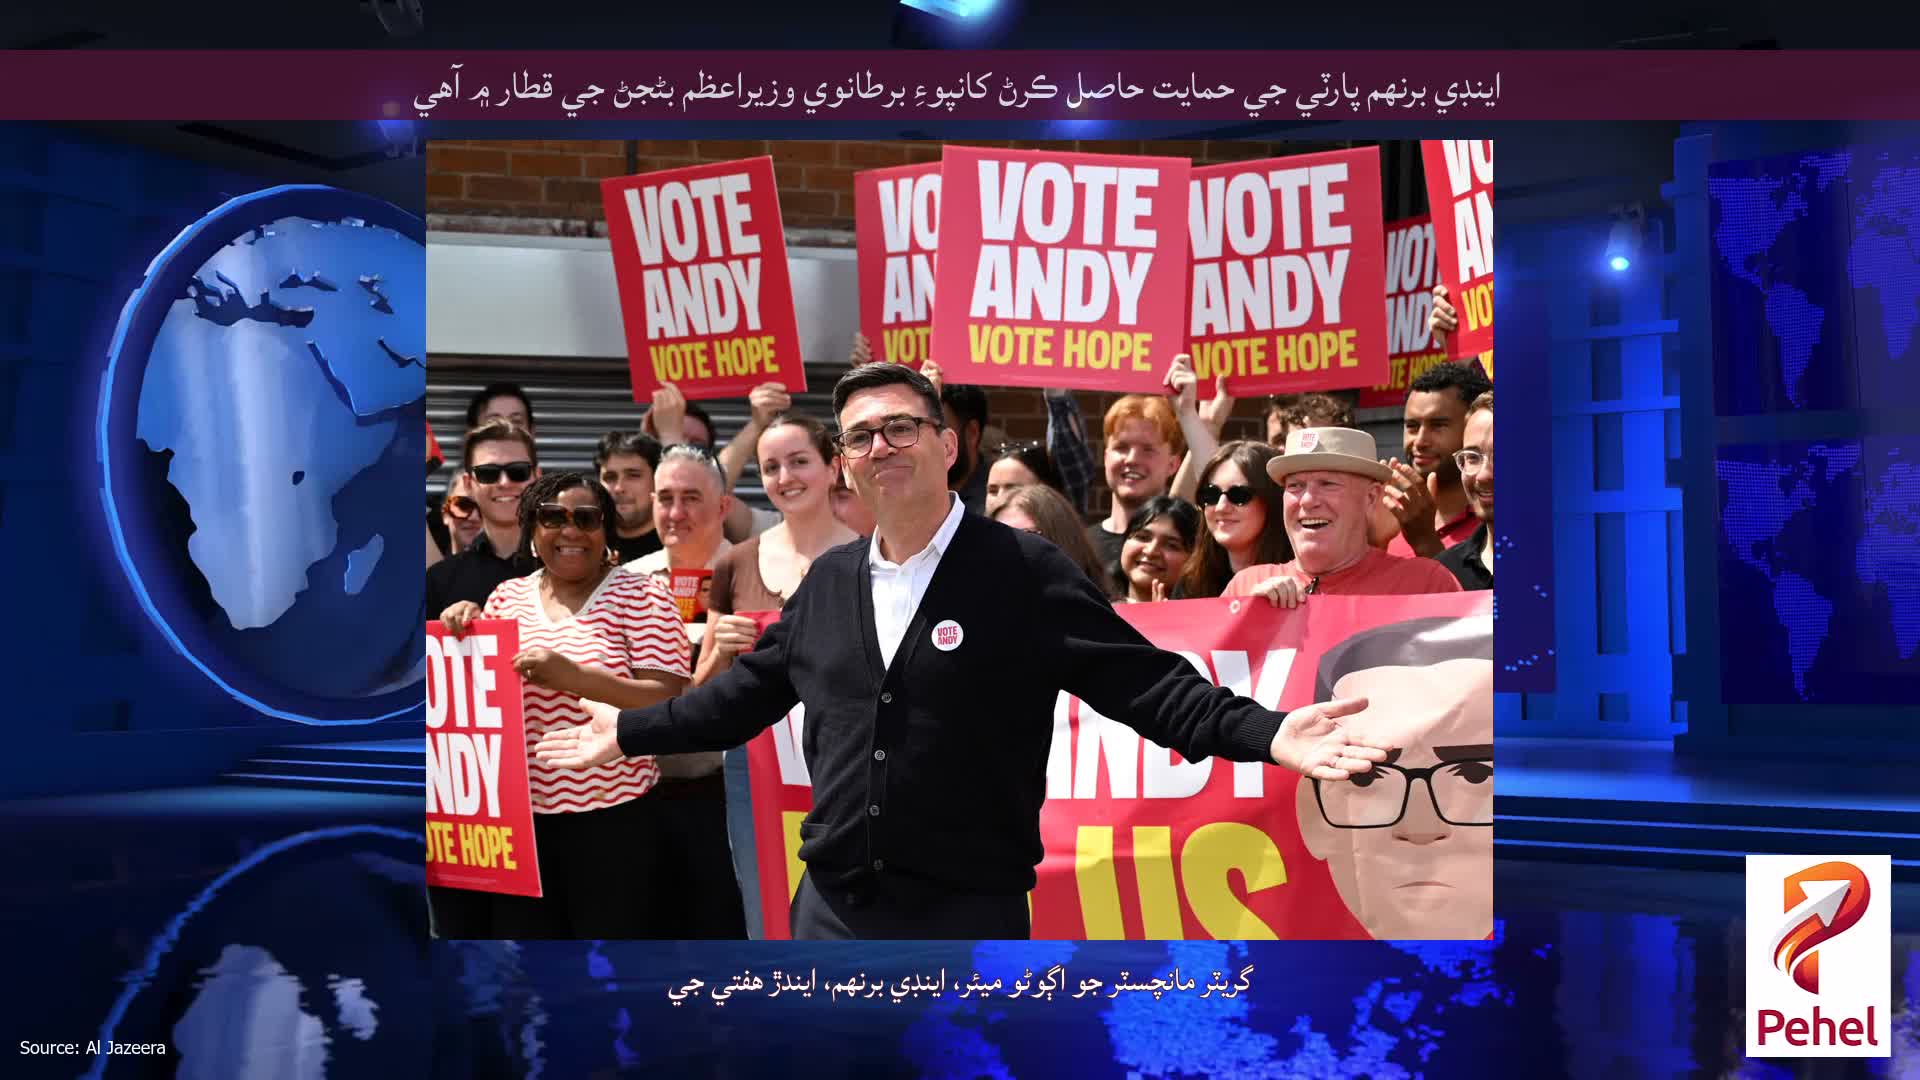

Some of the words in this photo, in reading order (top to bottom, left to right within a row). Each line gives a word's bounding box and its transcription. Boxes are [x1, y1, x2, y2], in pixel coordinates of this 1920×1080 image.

[624, 173, 760, 266] VOTE
[978, 160, 1159, 248] VOTE
[1188, 163, 1352, 259] VOTE
[969, 245, 1154, 325] ANDY
[1386, 223, 1441, 294] VOT
[642, 257, 761, 340] ANDY
[1190, 249, 1350, 336] ANDY
[1386, 292, 1441, 354] ND
[1461, 280, 1493, 331] VO
[649, 341, 713, 382] VOTE
[713, 336, 780, 377] HOPE
[968, 325, 1055, 366] VOTE
[1063, 328, 1152, 371] HOPE
[1191, 338, 1269, 380] VOTE
[1276, 329, 1358, 373] HOPE
[937, 626, 958, 637] VOTE
[938, 635, 957, 646] ANDY
[458, 823, 517, 870] HOPE
